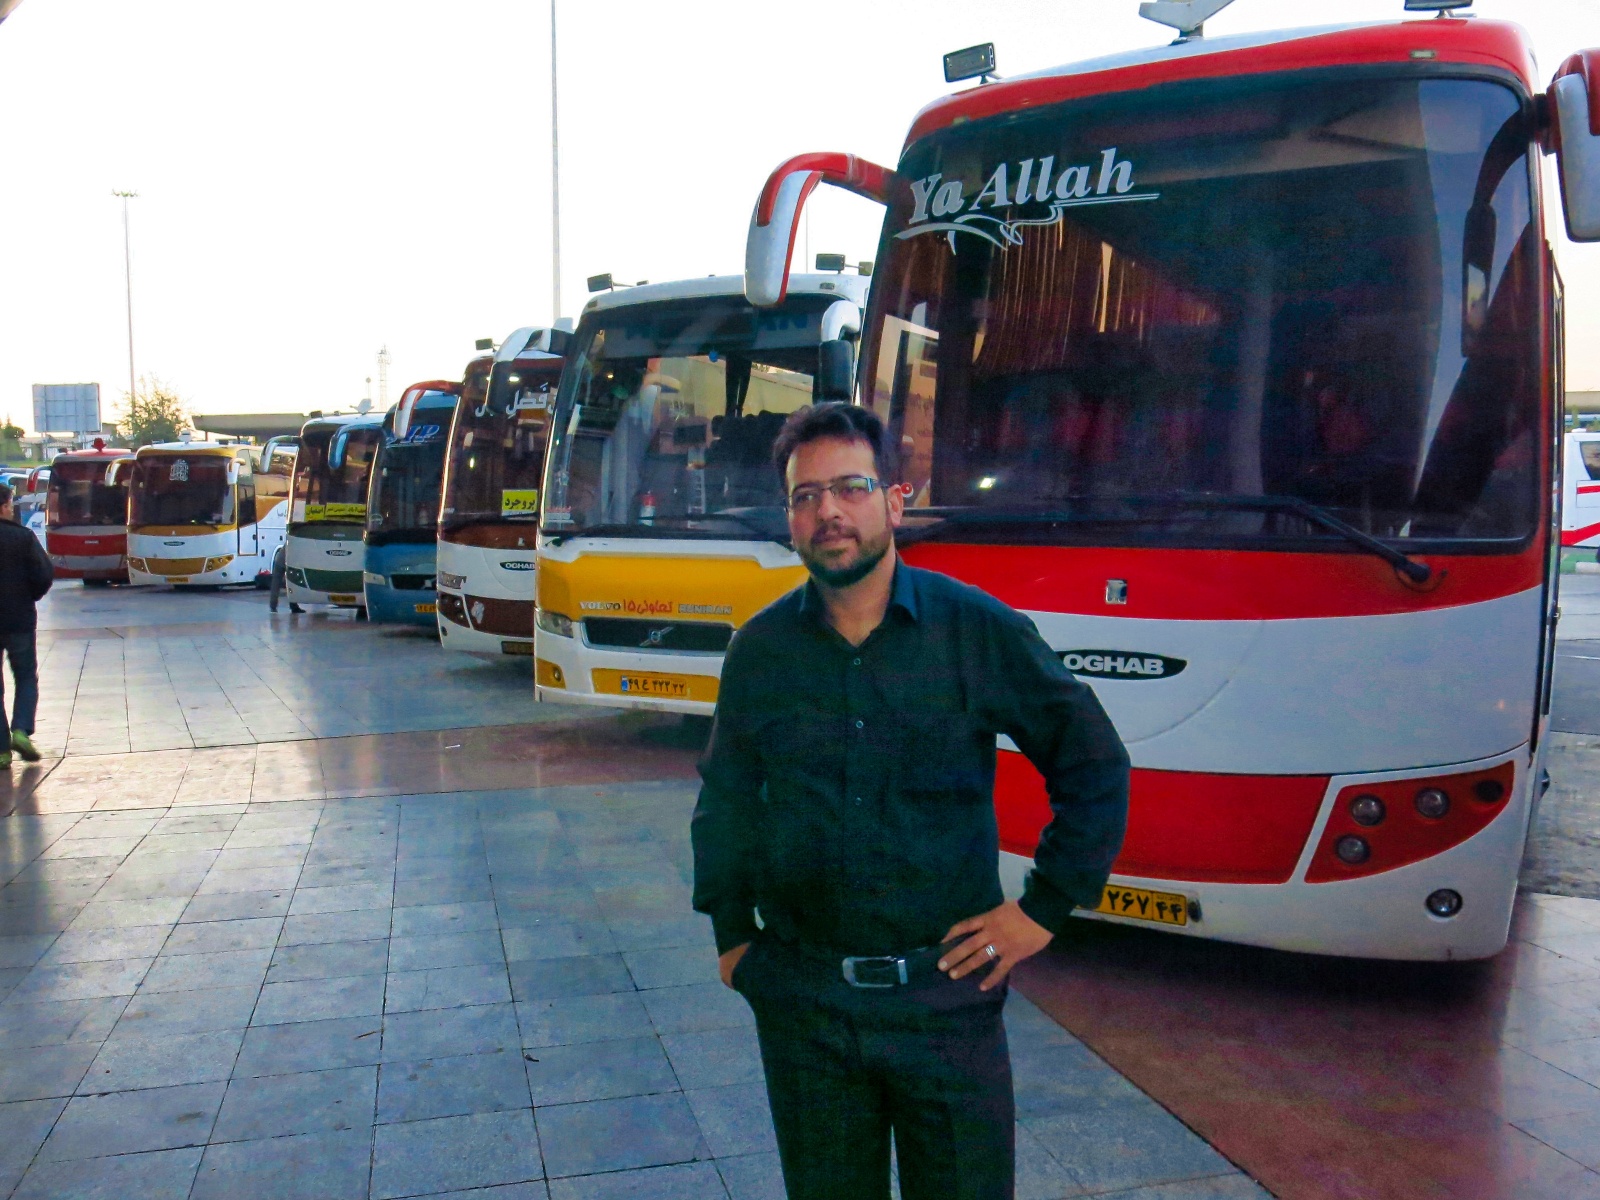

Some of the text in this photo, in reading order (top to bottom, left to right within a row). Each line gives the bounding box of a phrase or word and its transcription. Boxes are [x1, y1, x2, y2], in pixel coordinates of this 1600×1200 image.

[908, 147, 1134, 224] Ya Allah
[580, 601, 621, 611] VOLVO
[1063, 653, 1164, 675] OGHAB
[1107, 890, 1182, 922] ۲۶۷ ۴۴
